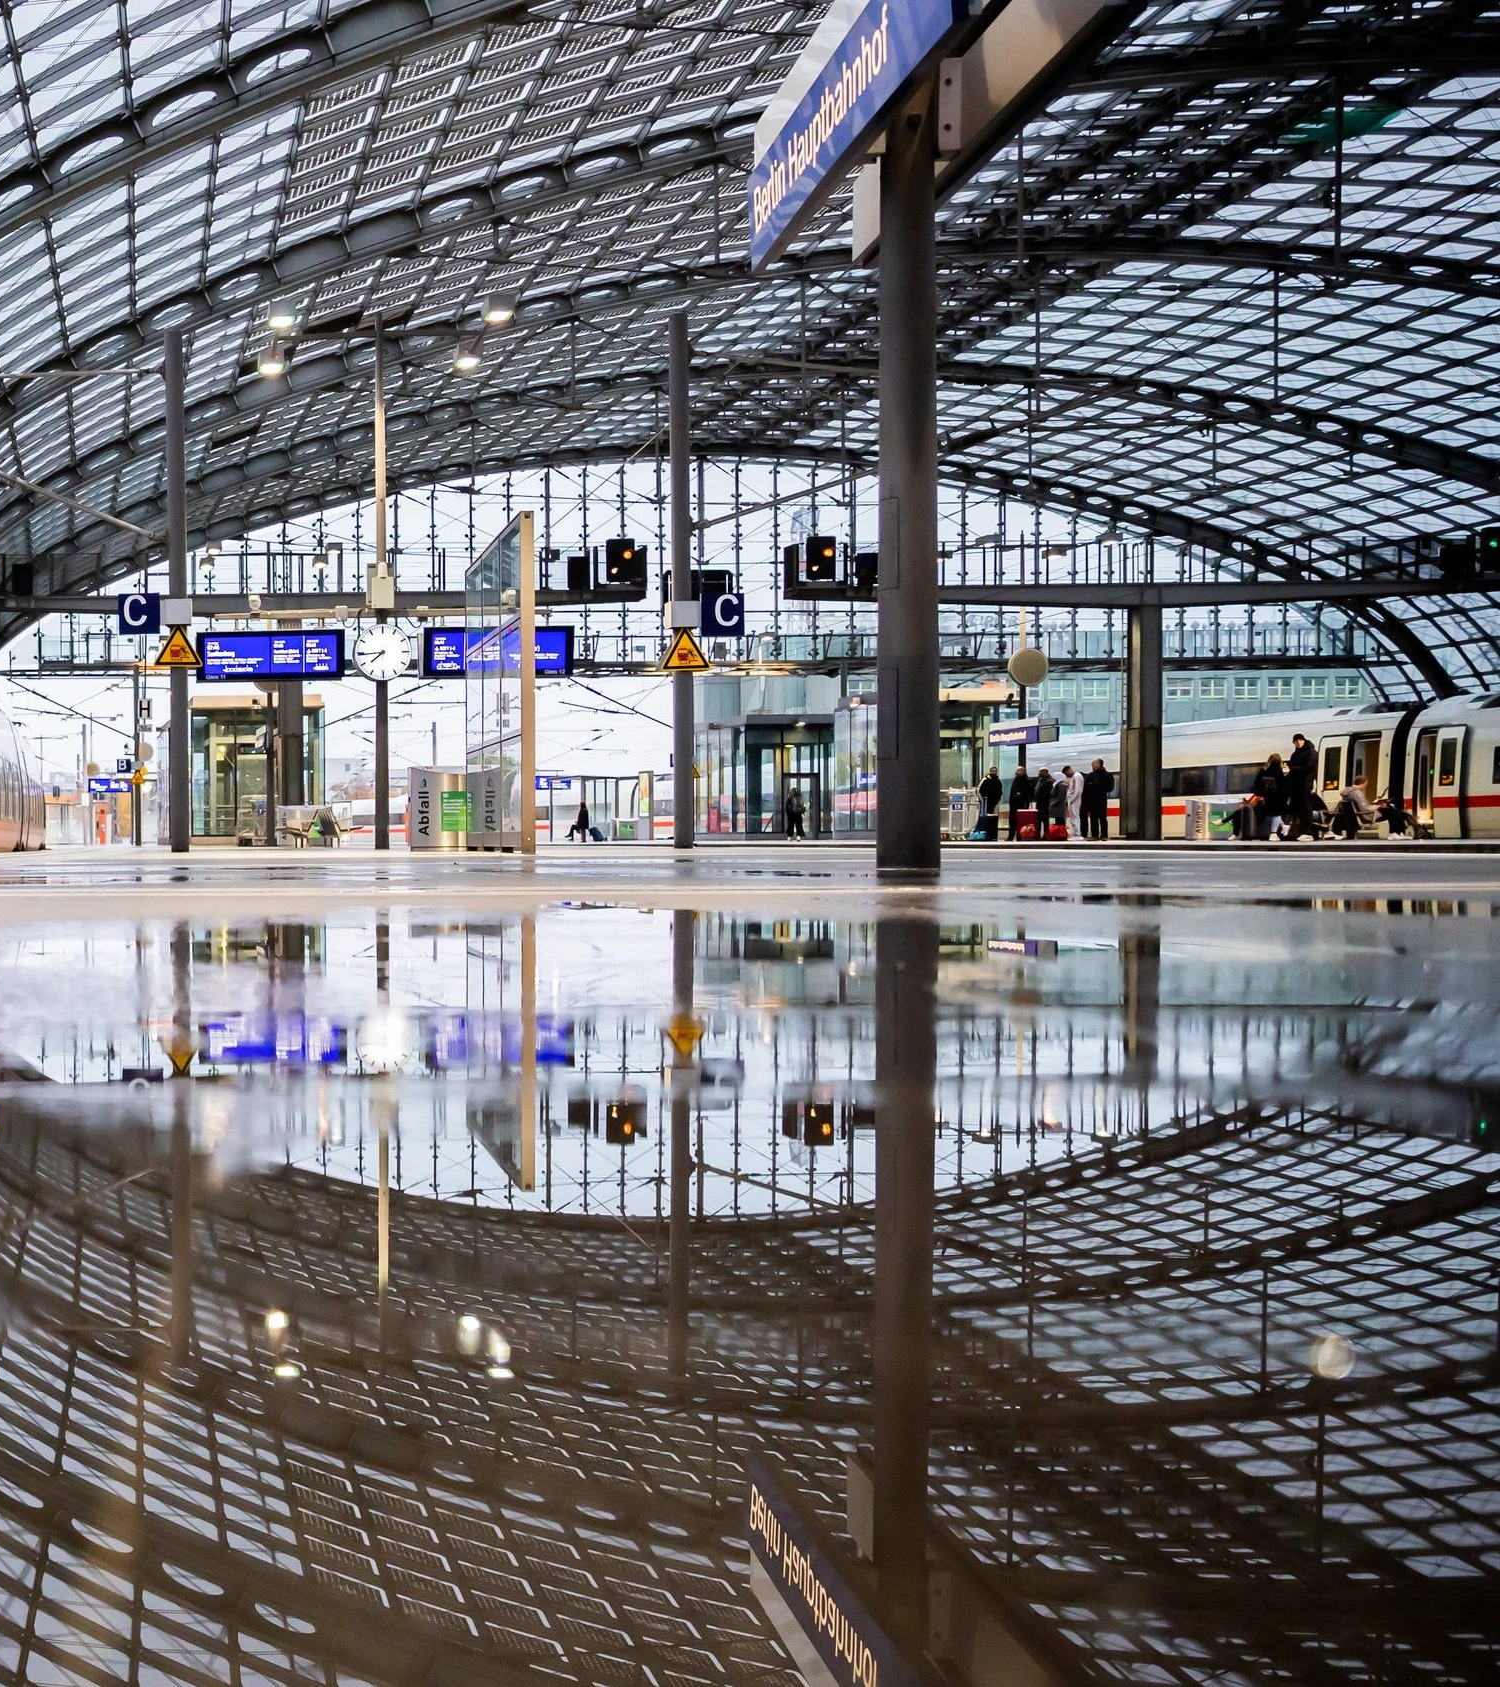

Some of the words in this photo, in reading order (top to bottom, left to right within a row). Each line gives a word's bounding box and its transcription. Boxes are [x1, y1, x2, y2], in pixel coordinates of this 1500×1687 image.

[753, 161, 787, 235] Berlin
[787, 3, 889, 188] Hauptbahnhof
[123, 594, 148, 626] C
[714, 594, 740, 627] C
[139, 700, 150, 718] H
[118, 759, 127, 771] B
[418, 790, 430, 836] Abfall
